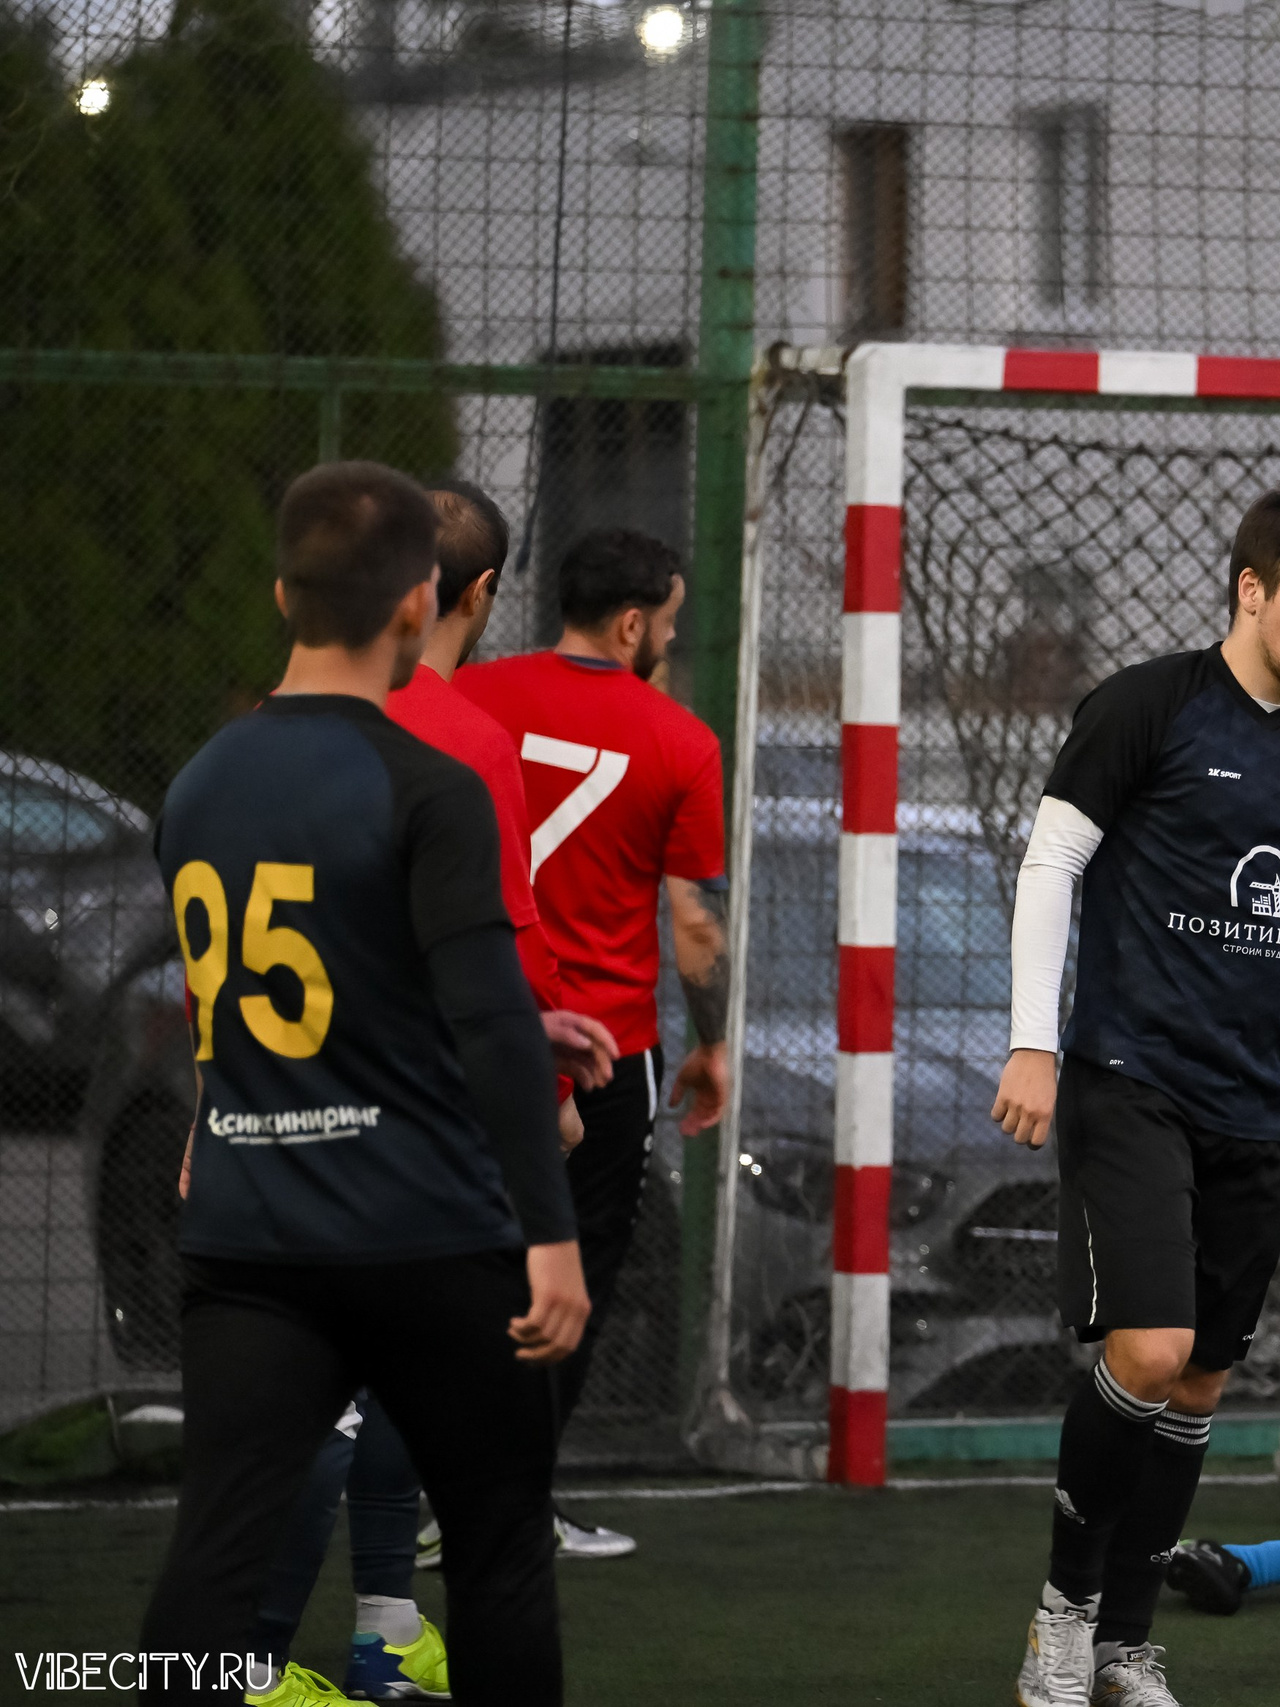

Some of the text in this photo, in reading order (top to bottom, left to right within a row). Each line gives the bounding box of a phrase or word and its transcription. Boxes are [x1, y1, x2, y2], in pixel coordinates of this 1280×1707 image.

[521, 731, 630, 887] 7
[1208, 768, 1242, 780] 2K SPORT
[173, 859, 334, 1061] 95
[1222, 943, 1263, 957] СТРОИМ
